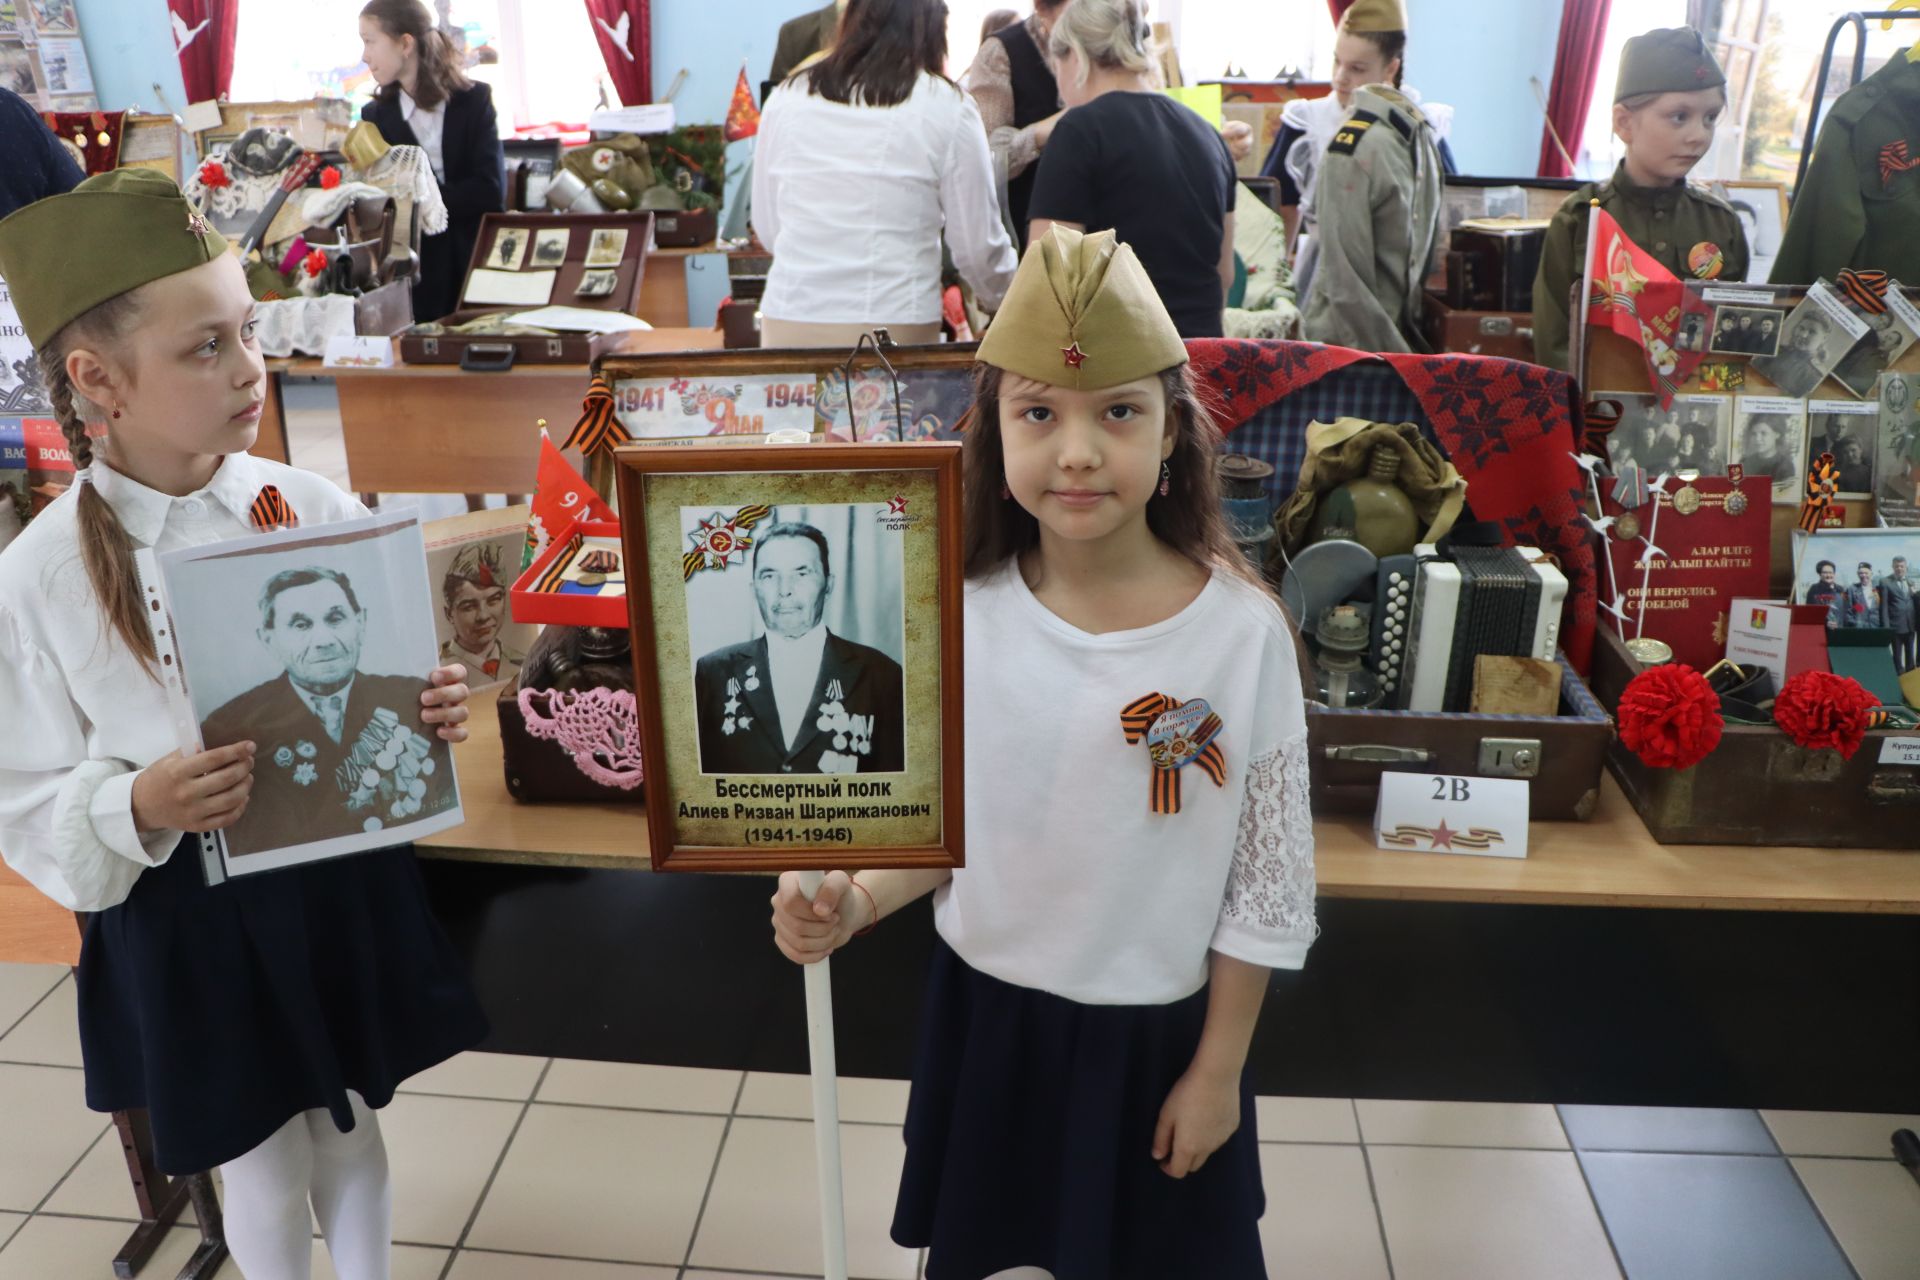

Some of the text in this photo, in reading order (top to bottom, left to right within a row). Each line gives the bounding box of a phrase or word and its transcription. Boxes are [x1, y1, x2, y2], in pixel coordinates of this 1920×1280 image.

[614, 386, 665, 412] 1941
[764, 383, 816, 408] 1945
[559, 491, 579, 508] 9
[1691, 547, 1721, 556] АЛАР
[1670, 560, 1703, 568] АЛЫП
[1706, 558, 1752, 568] КАЙТТЫ
[1654, 587, 1717, 596] ВЕРНУЛИСЬ
[716, 778, 892, 802] Бессмертный полк
[1431, 776, 1471, 801] 2В
[679, 802, 930, 822] Алиев Ризван Шарипжанович
